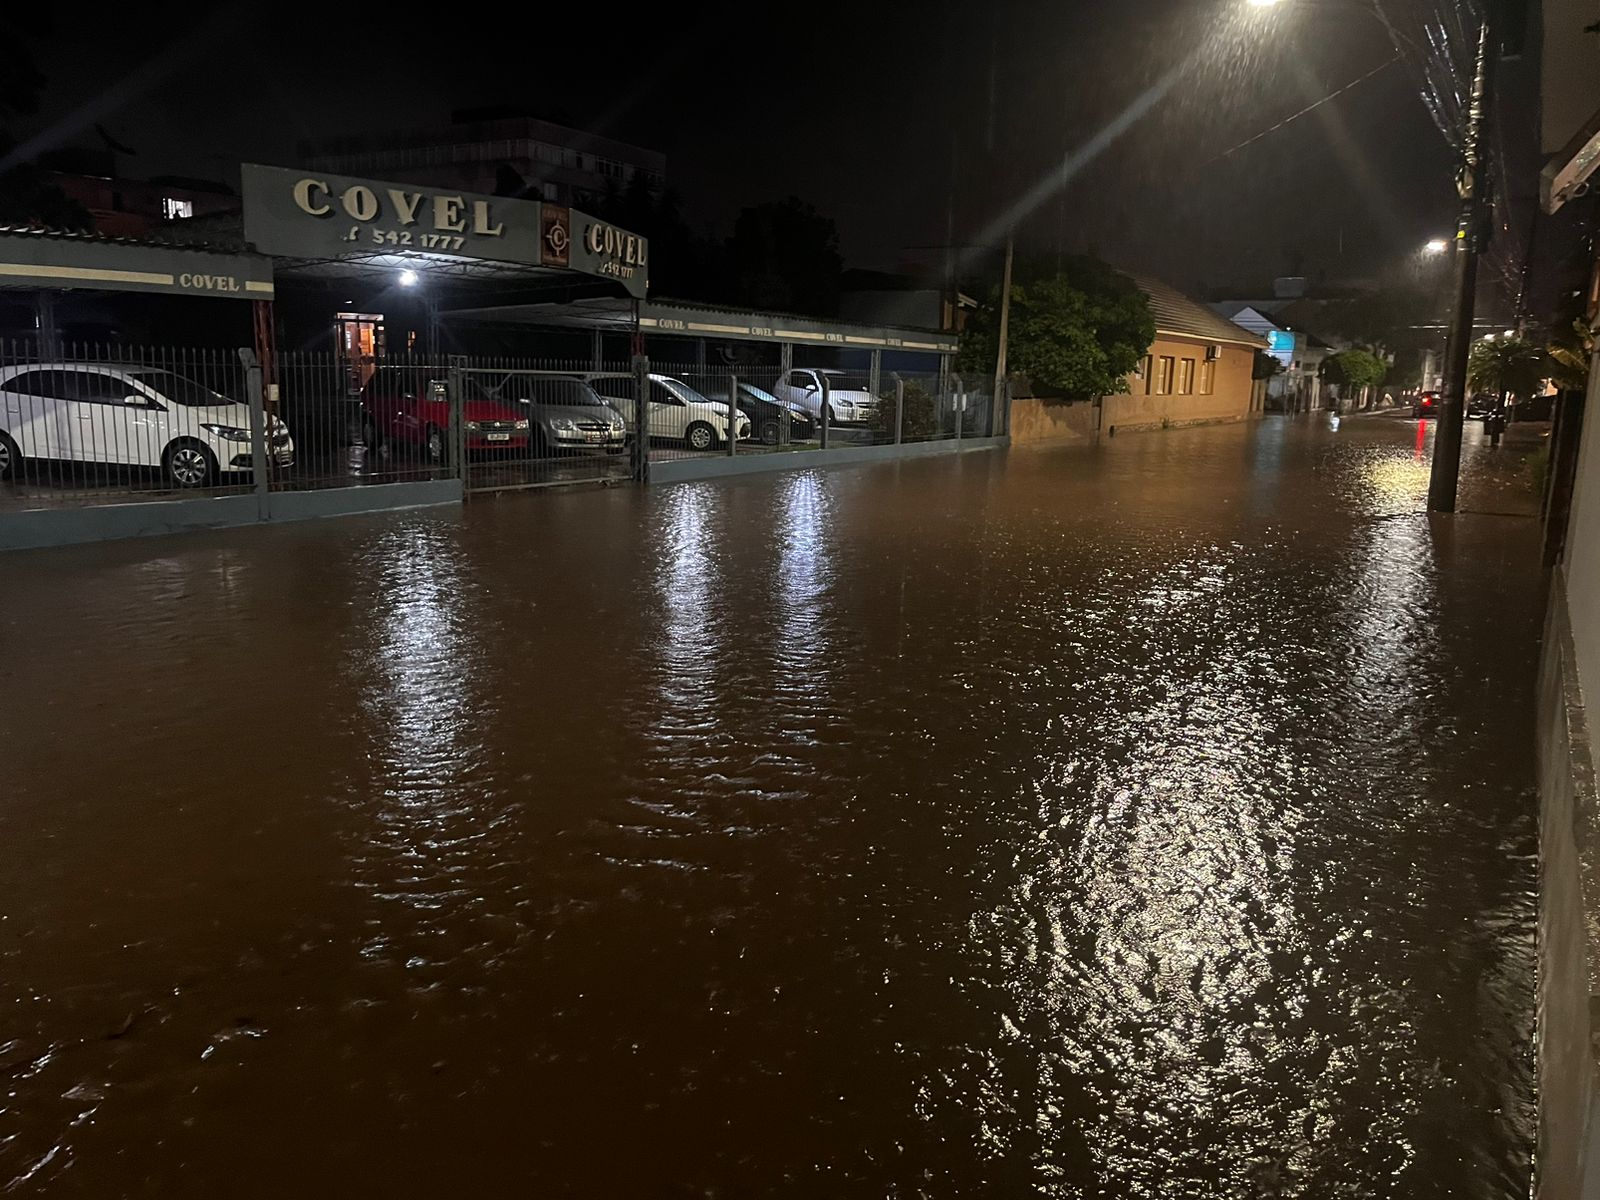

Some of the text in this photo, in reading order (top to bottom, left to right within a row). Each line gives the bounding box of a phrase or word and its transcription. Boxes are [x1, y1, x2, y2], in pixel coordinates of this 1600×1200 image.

[293, 178, 503, 237] COVEL
[372, 227, 465, 250] 542 1777
[591, 223, 646, 266] COVEL
[607, 262, 620, 276] 542
[179, 273, 240, 292] COVEL
[658, 318, 685, 330] COVEL
[751, 326, 773, 337] COVEL
